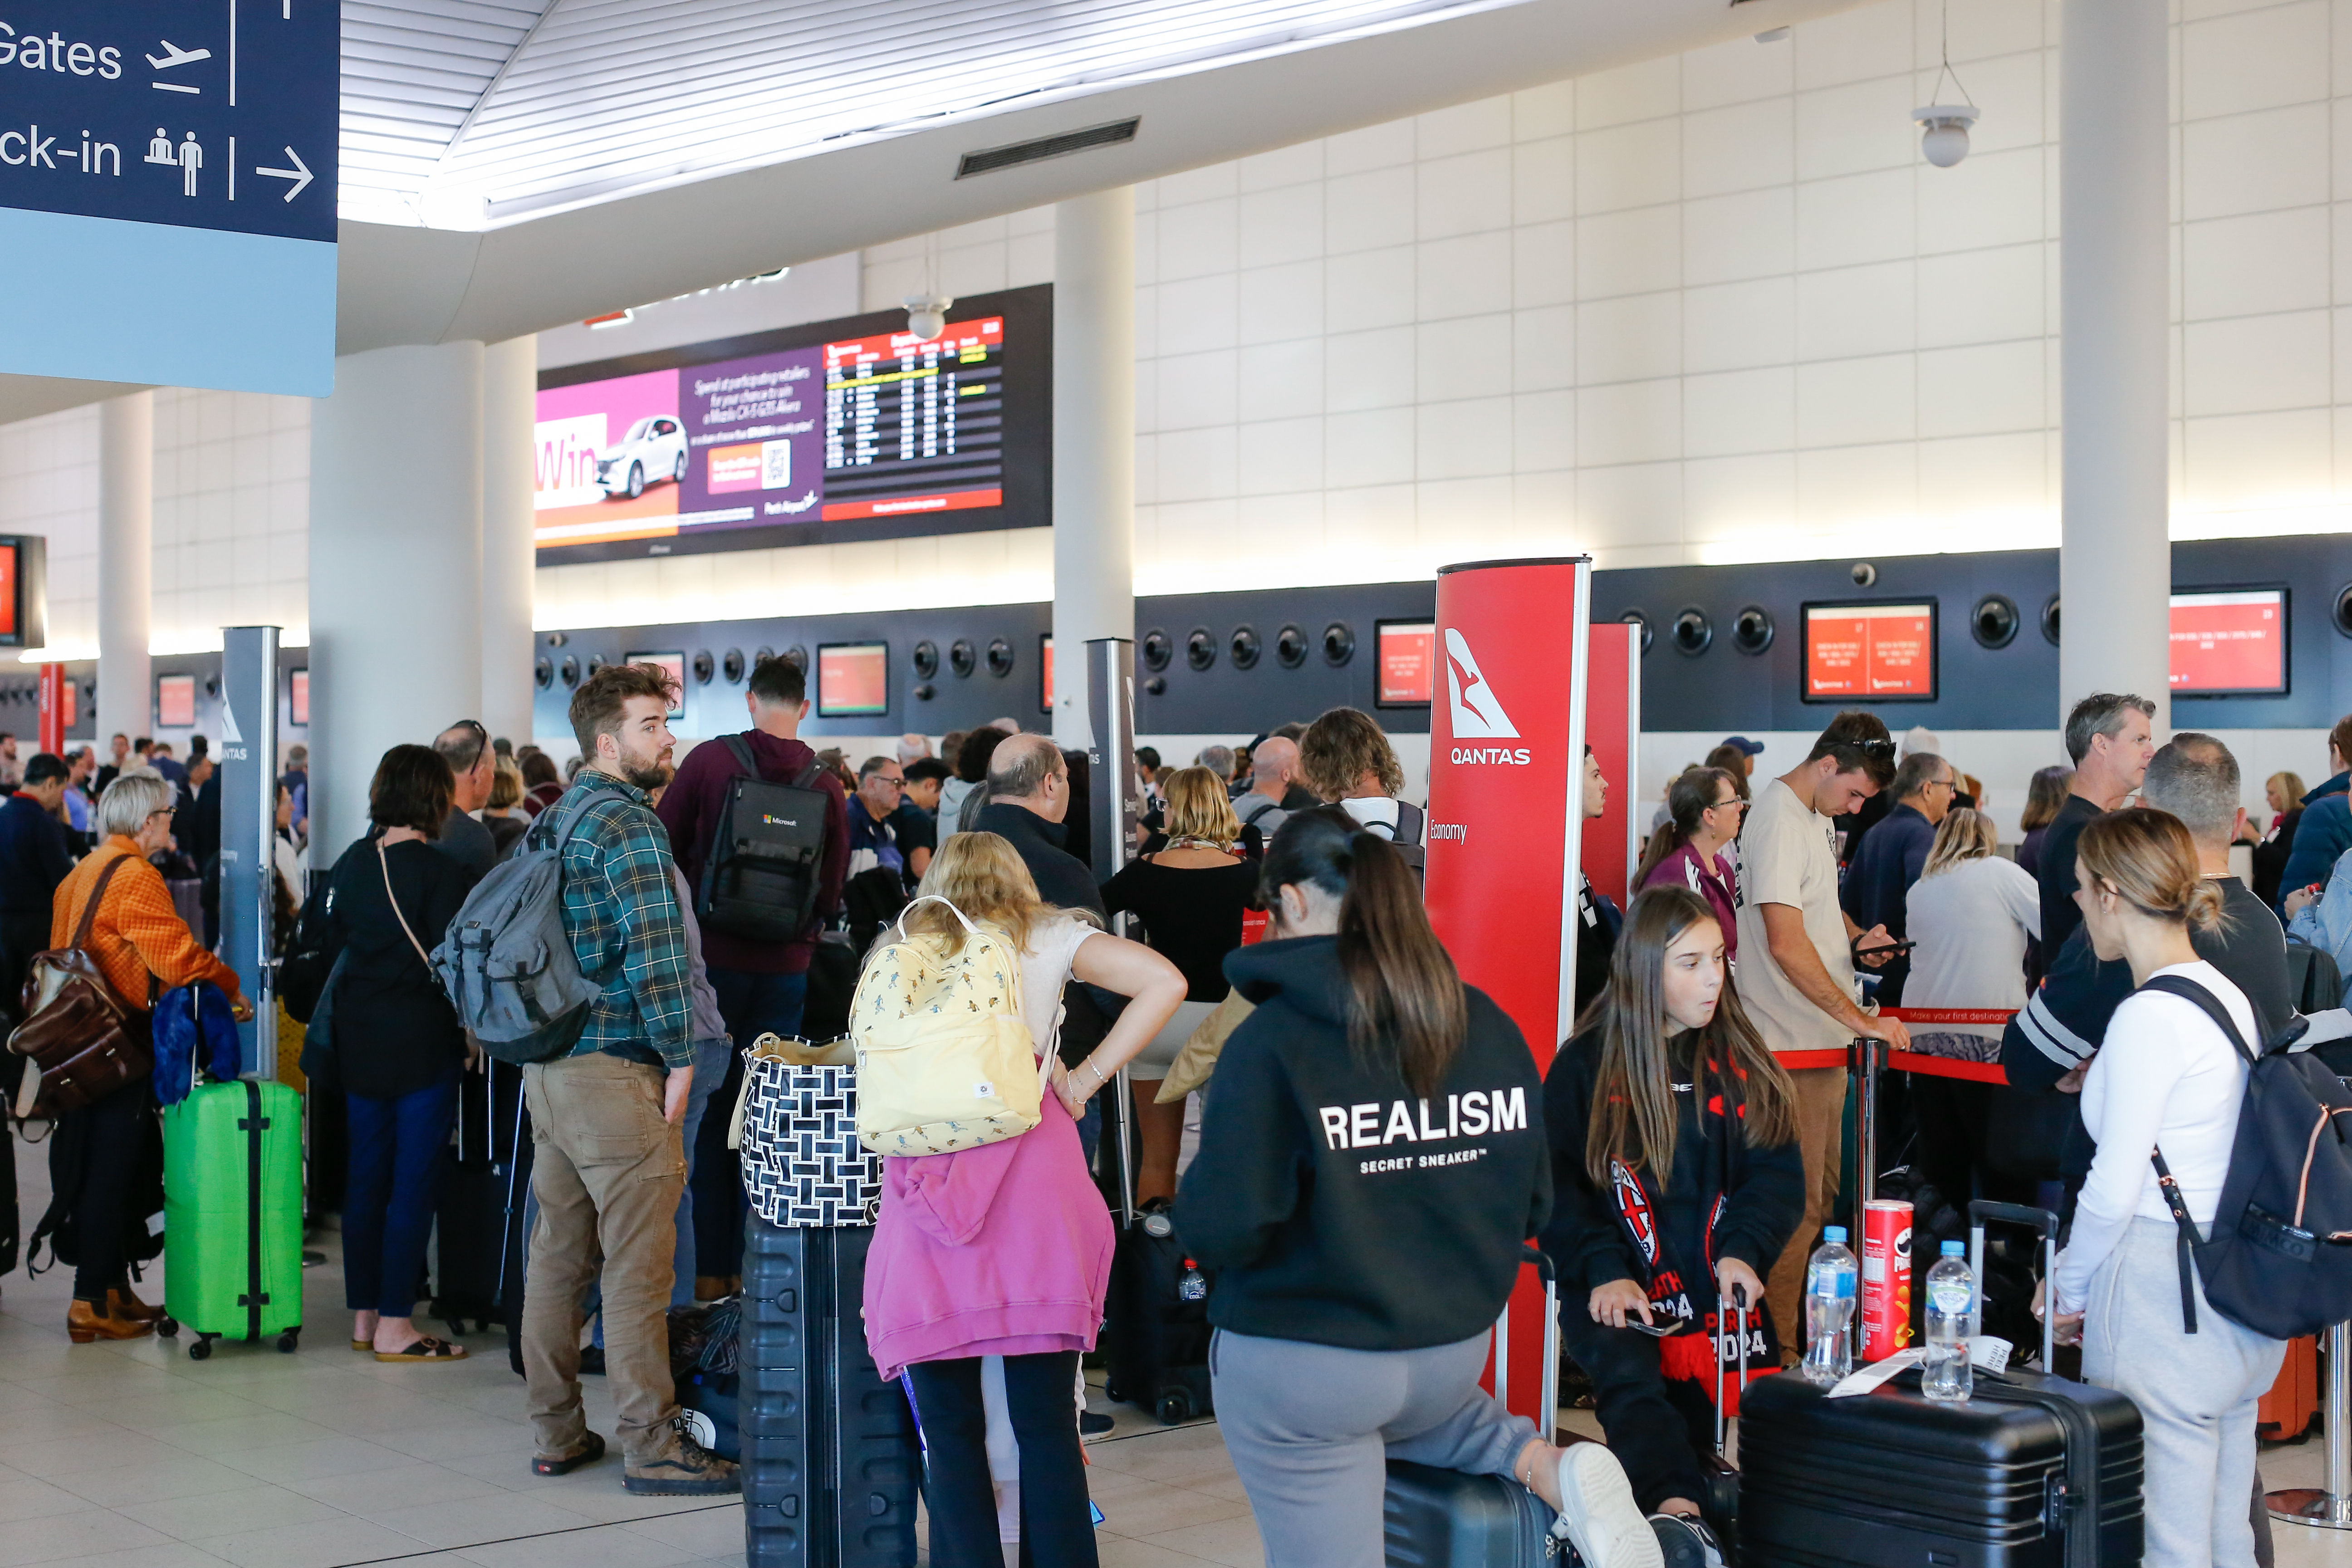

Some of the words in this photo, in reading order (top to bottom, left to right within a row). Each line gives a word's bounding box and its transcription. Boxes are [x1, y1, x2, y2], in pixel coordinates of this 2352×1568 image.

[1451, 747, 1531, 765] QANTAS
[772, 817, 797, 826] Microsoft
[1431, 818, 1467, 846] Economy
[1910, 1011, 1931, 1020] Make
[1933, 1013, 1950, 1021] your
[1953, 1012, 1968, 1020] first
[1319, 1086, 1528, 1150] REALISM
[1360, 1156, 1413, 1174] SECRET
[1986, 1344, 2000, 1368] HERE
[1994, 1349, 2008, 1368] PEEL
